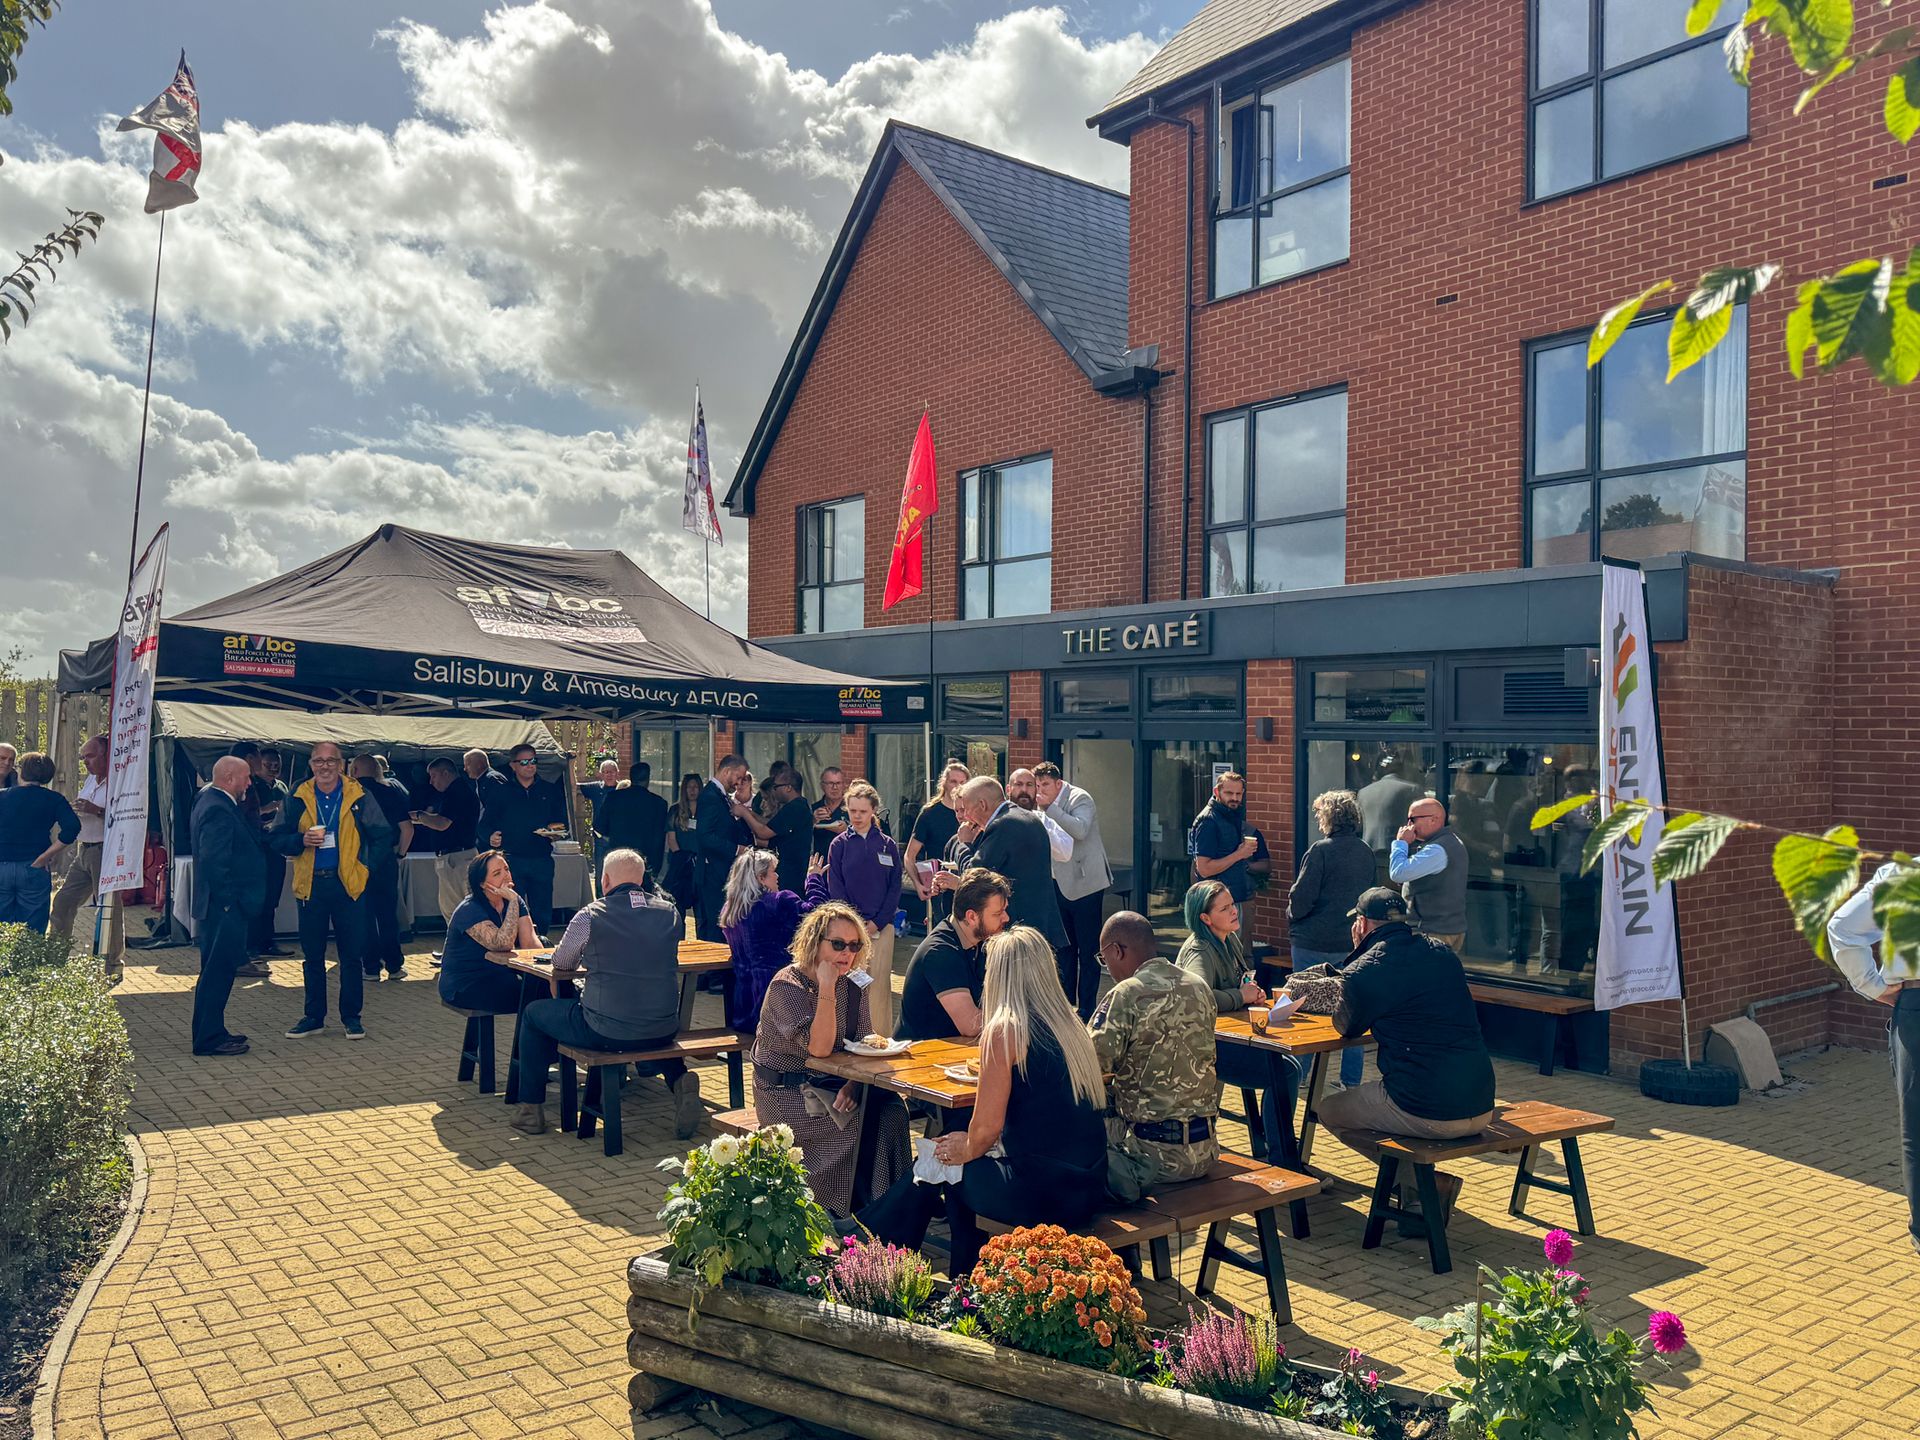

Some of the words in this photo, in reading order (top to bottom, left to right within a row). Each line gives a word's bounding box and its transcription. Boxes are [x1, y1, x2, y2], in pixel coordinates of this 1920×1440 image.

[1062, 627, 1111, 653] THE
[1122, 613, 1198, 650] CAFÉ
[224, 653, 269, 663] BREAKFAST
[270, 656, 296, 665] CLUBS
[225, 664, 257, 672] SALISBURY
[262, 667, 294, 675] AMESBURY
[413, 658, 533, 695] Salisbury
[542, 671, 560, 692] &
[566, 674, 679, 707] Amesbury
[686, 690, 759, 709] AFVBC
